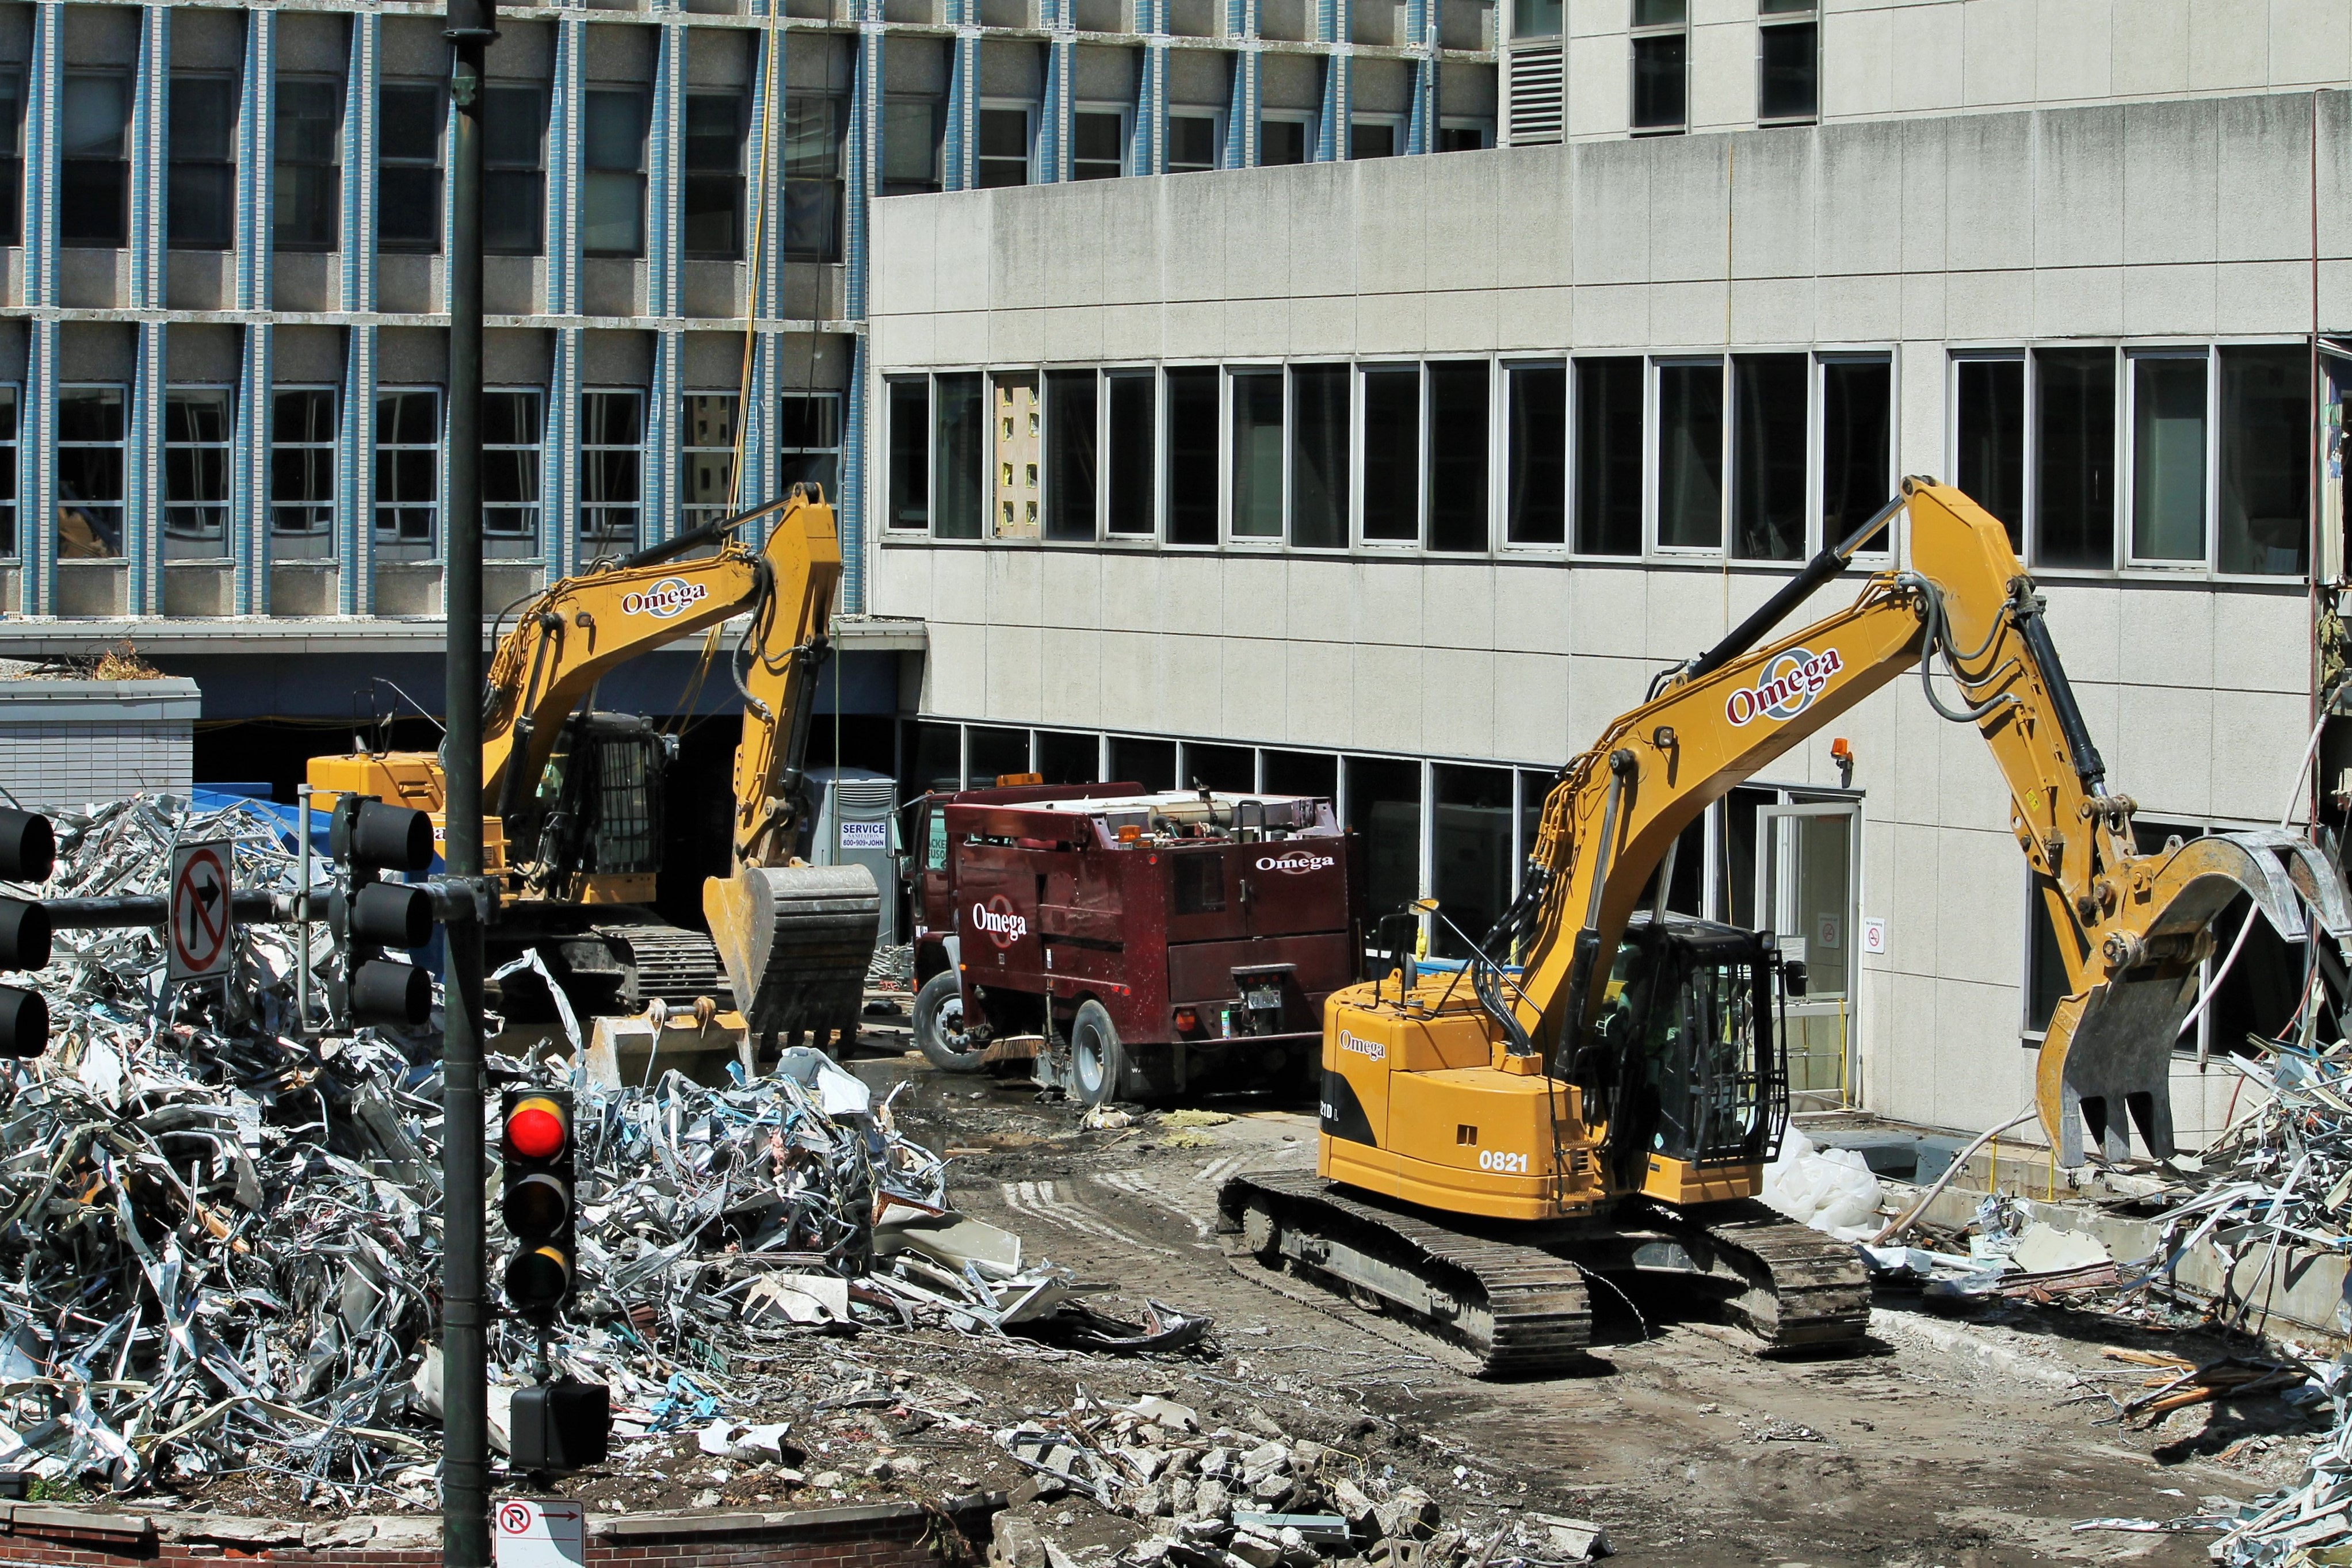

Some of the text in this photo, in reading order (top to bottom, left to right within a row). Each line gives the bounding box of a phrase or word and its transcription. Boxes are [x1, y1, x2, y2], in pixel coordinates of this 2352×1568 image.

[622, 583, 707, 614] Omega
[1727, 649, 1842, 725] Omega
[843, 824, 885, 833] SERVICE
[1256, 854, 1335, 870] Omega
[973, 902, 1027, 942] Omega
[1339, 1030, 1386, 1062] Omega
[1479, 1150, 1528, 1173] 0821
[509, 1509, 524, 1528] P
